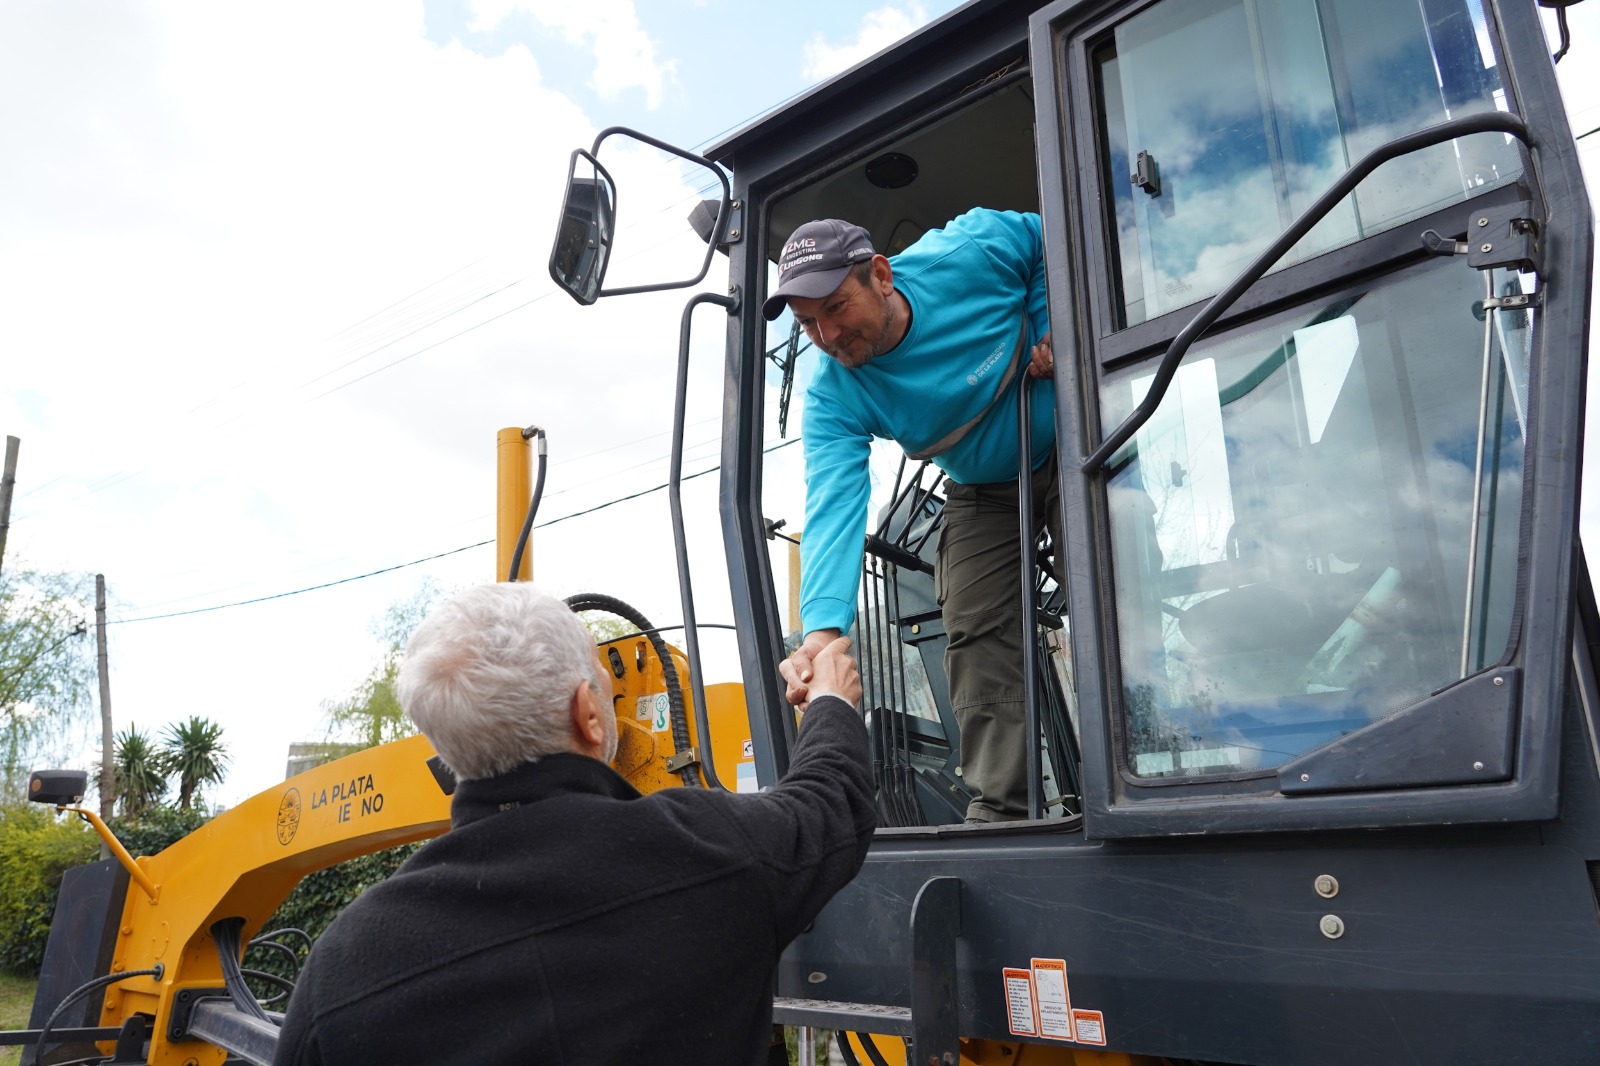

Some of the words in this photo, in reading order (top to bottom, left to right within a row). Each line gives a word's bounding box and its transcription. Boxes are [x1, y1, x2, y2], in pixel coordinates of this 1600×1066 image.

[974, 342, 1005, 374] MUNICIPALIDAD
[990, 351, 1004, 365] PLATA
[312, 789, 327, 809] LA
[331, 774, 375, 804] PLATA
